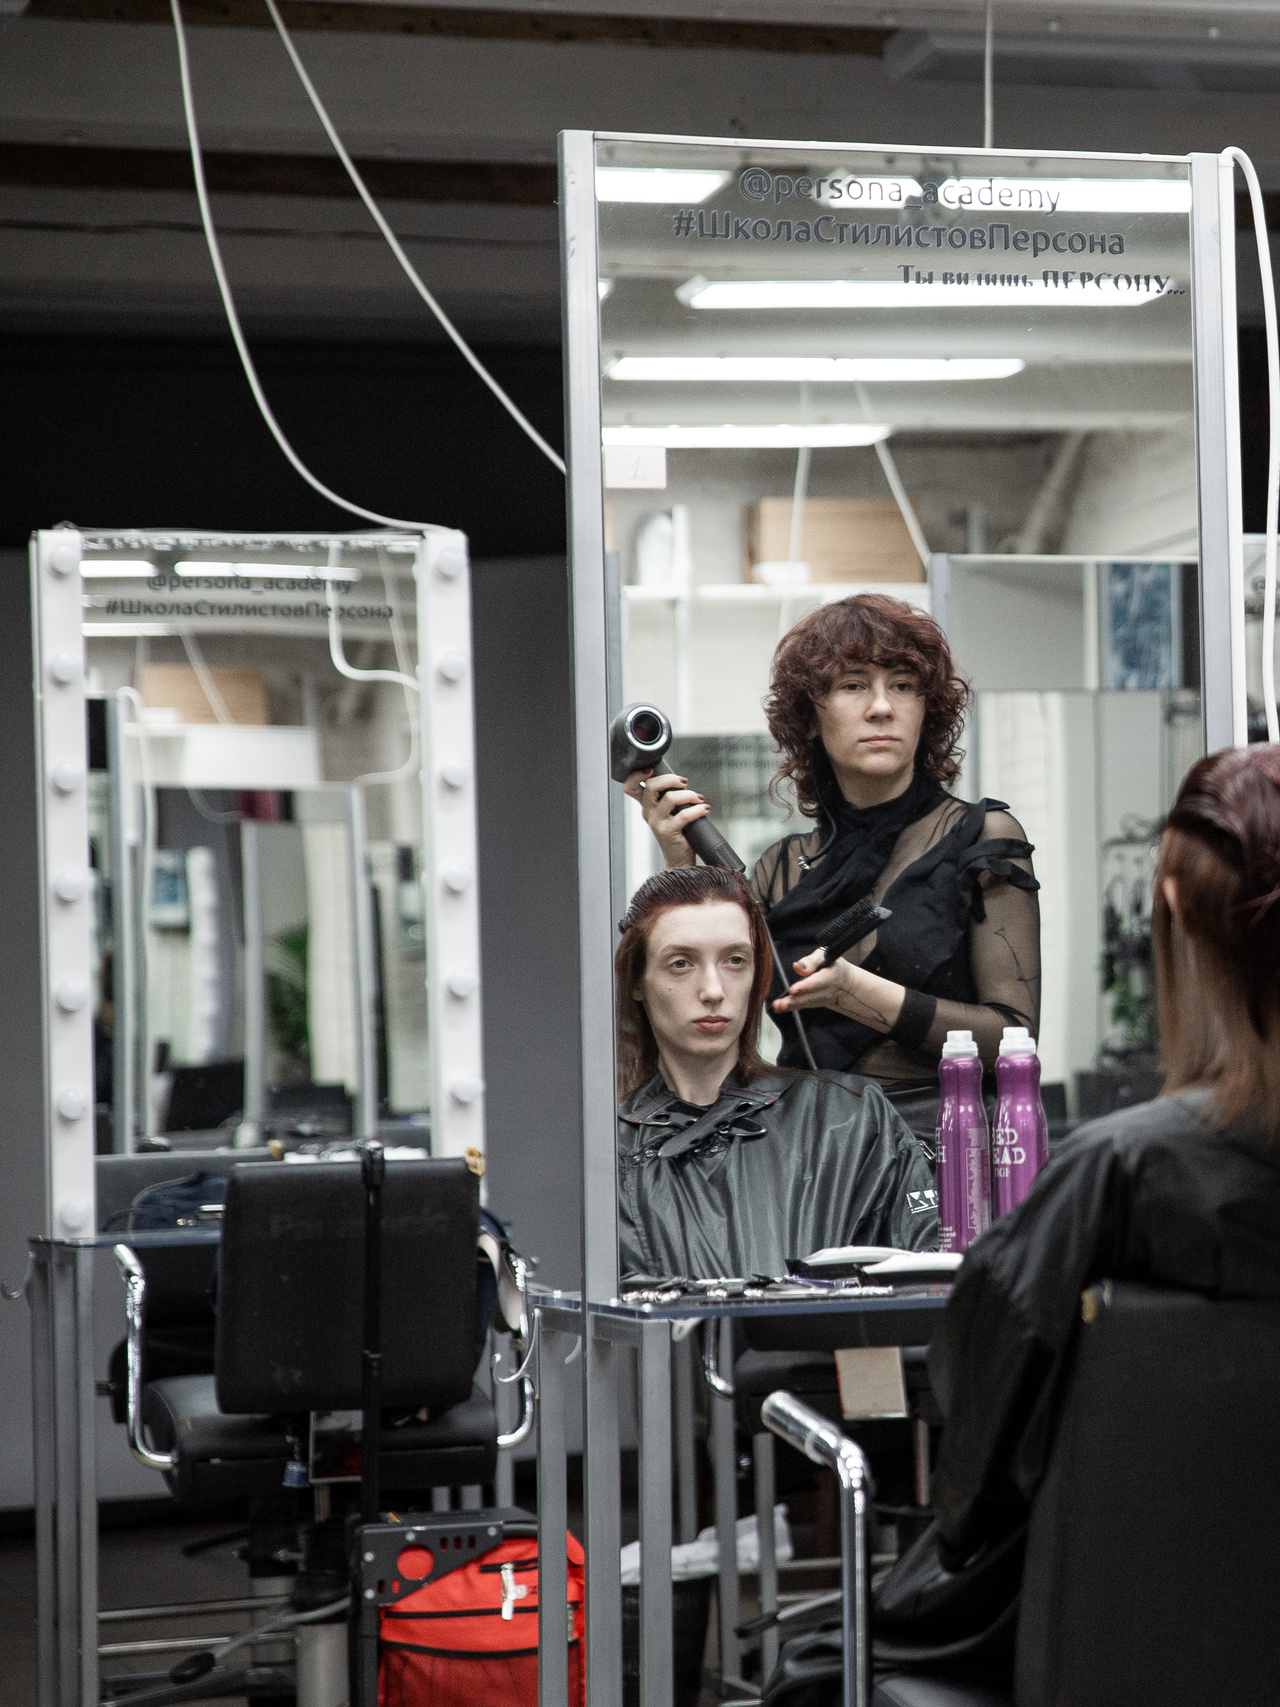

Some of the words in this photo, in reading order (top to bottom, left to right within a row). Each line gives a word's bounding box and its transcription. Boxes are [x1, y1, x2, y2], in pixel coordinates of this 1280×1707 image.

[739, 167, 1060, 215] @persona_academy
[672, 210, 1125, 257] #ШколаСтилистовПерсона
[897, 264, 934, 285] Ты
[147, 574, 353, 595] @persona_acadey
[993, 1147, 1026, 1165] EAD
